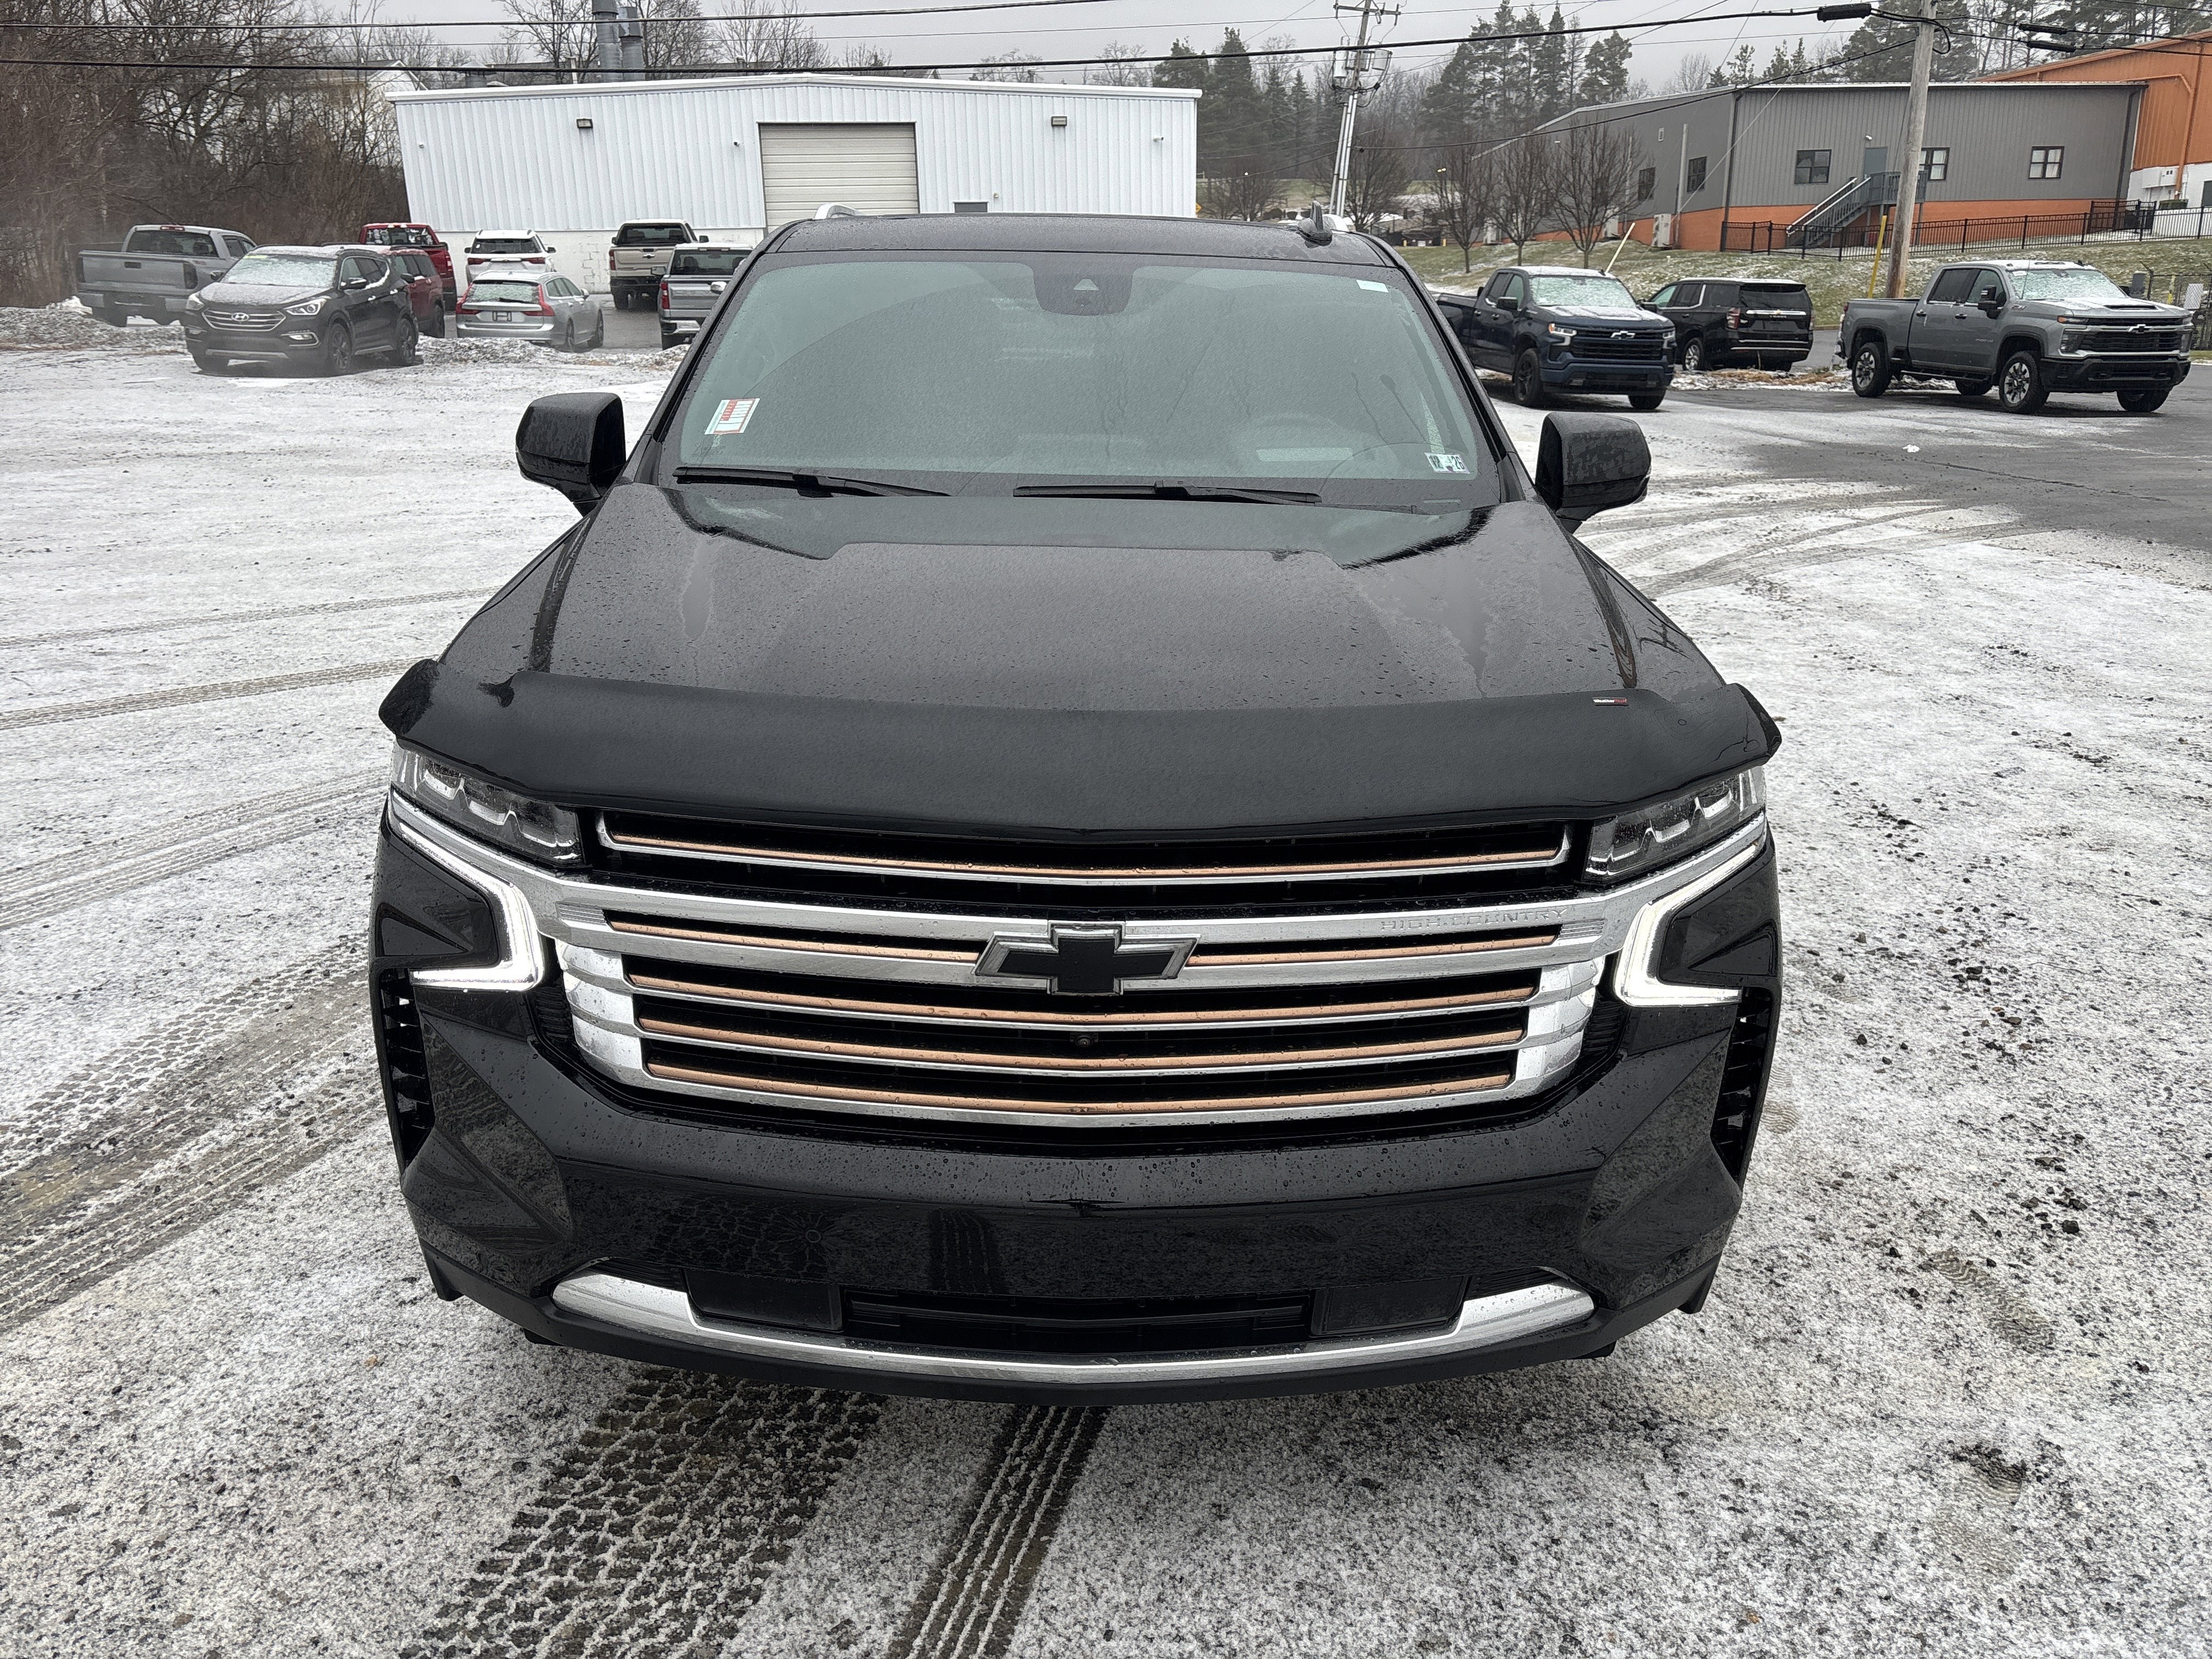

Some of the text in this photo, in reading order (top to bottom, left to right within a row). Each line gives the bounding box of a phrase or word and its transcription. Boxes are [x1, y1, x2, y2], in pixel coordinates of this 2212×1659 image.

[1429, 455, 1465, 470] 12 26
[1381, 908, 1567, 931] HIGH COUNTRY
